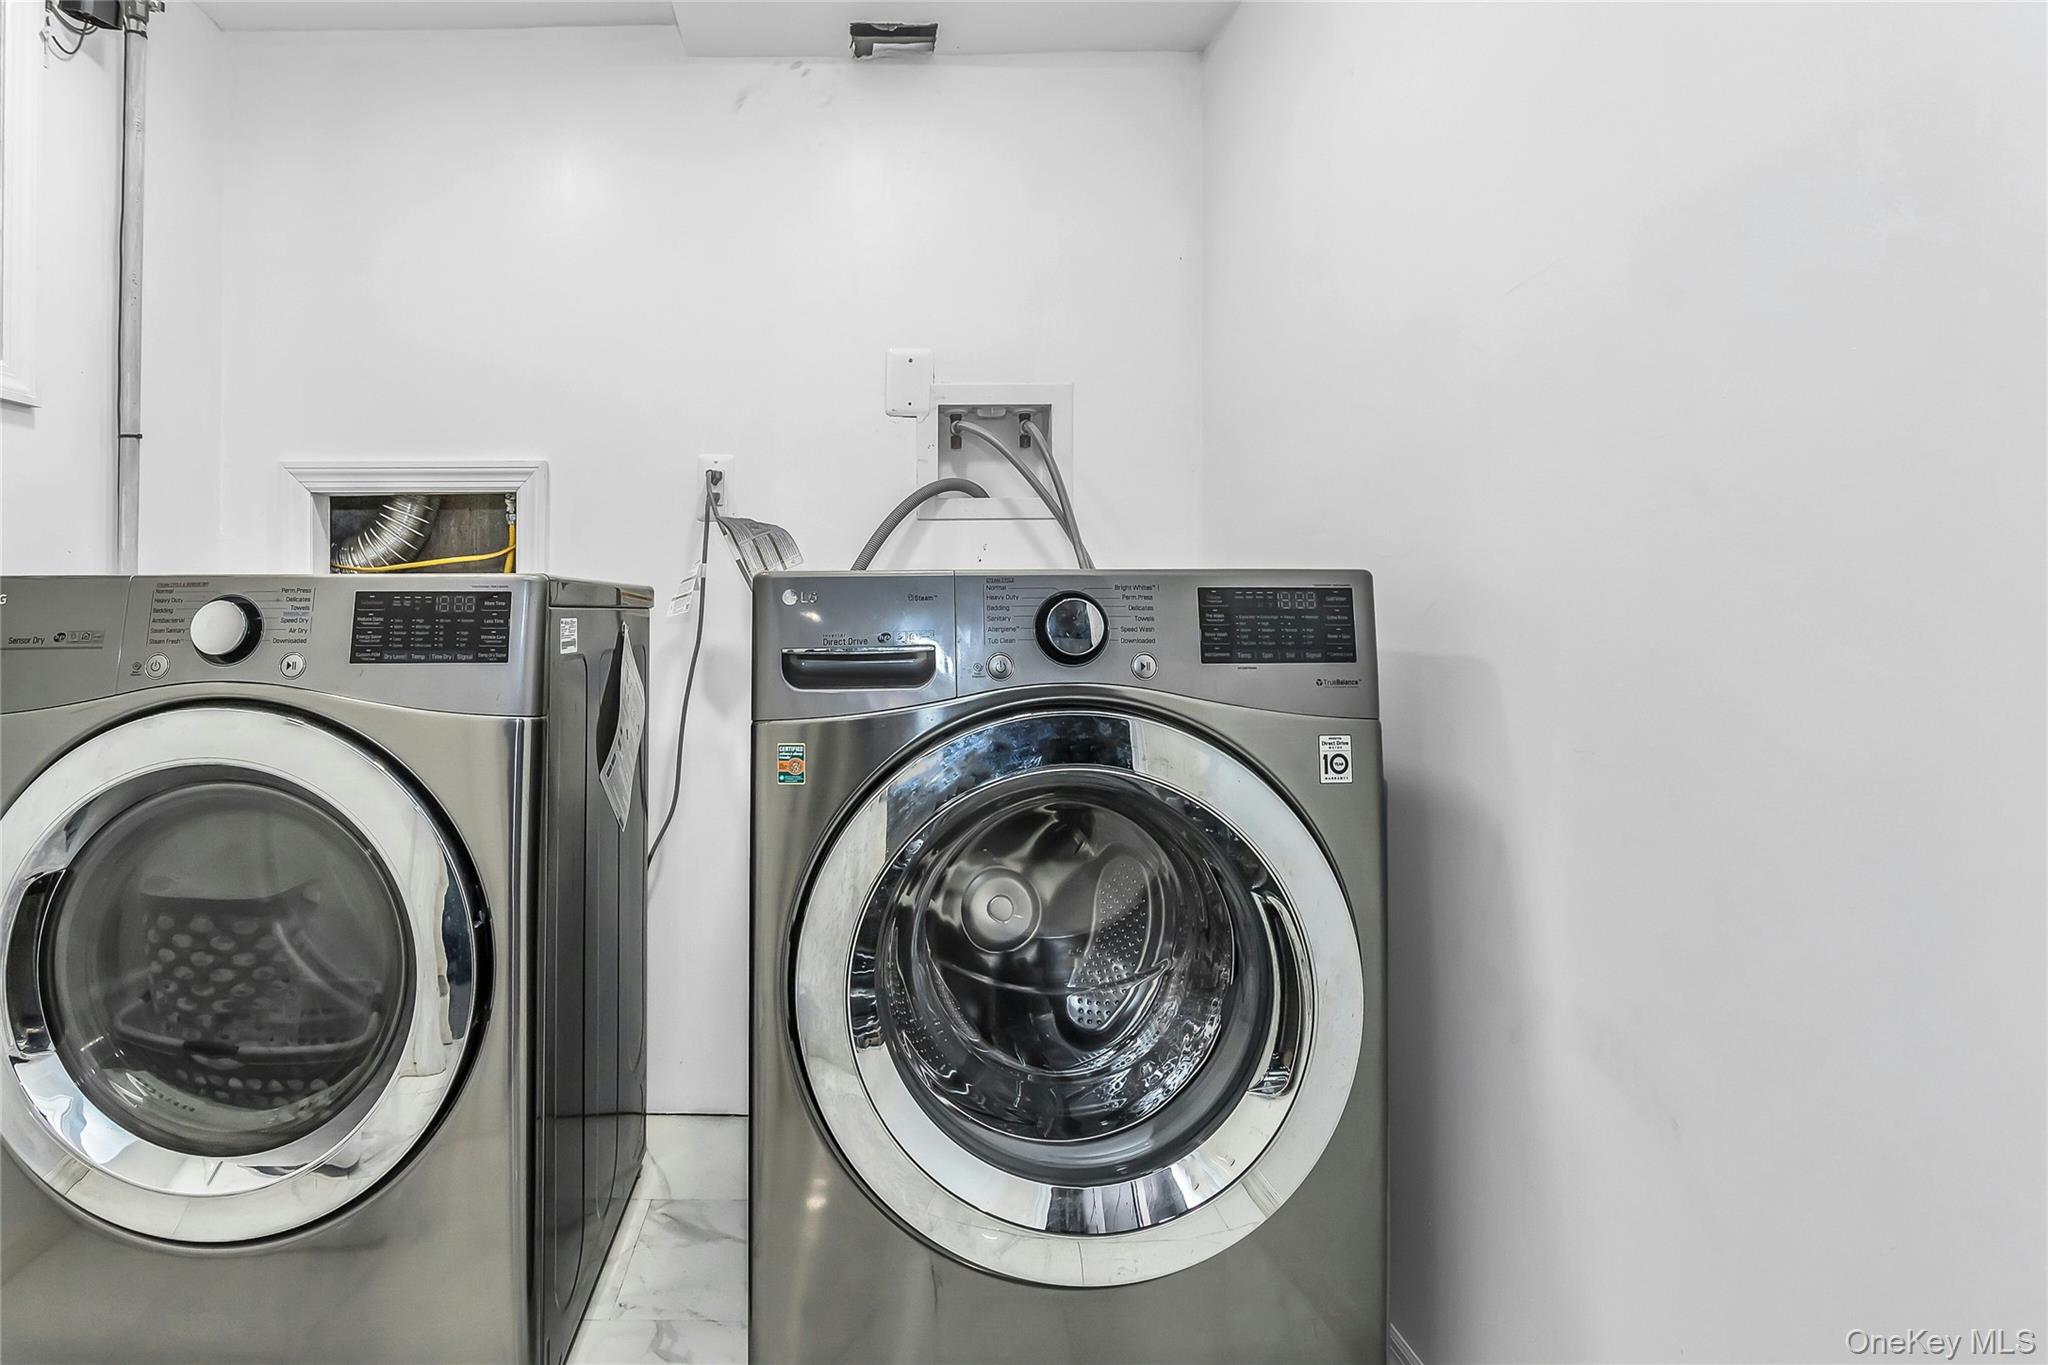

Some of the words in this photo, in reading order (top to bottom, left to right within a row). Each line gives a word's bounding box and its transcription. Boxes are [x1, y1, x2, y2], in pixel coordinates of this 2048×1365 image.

[8, 636, 31, 645] Sensor
[33, 636, 45, 646] Dry
[823, 637, 846, 646] Direct
[848, 637, 869, 645] Drive
[1323, 753, 1349, 775] 10
